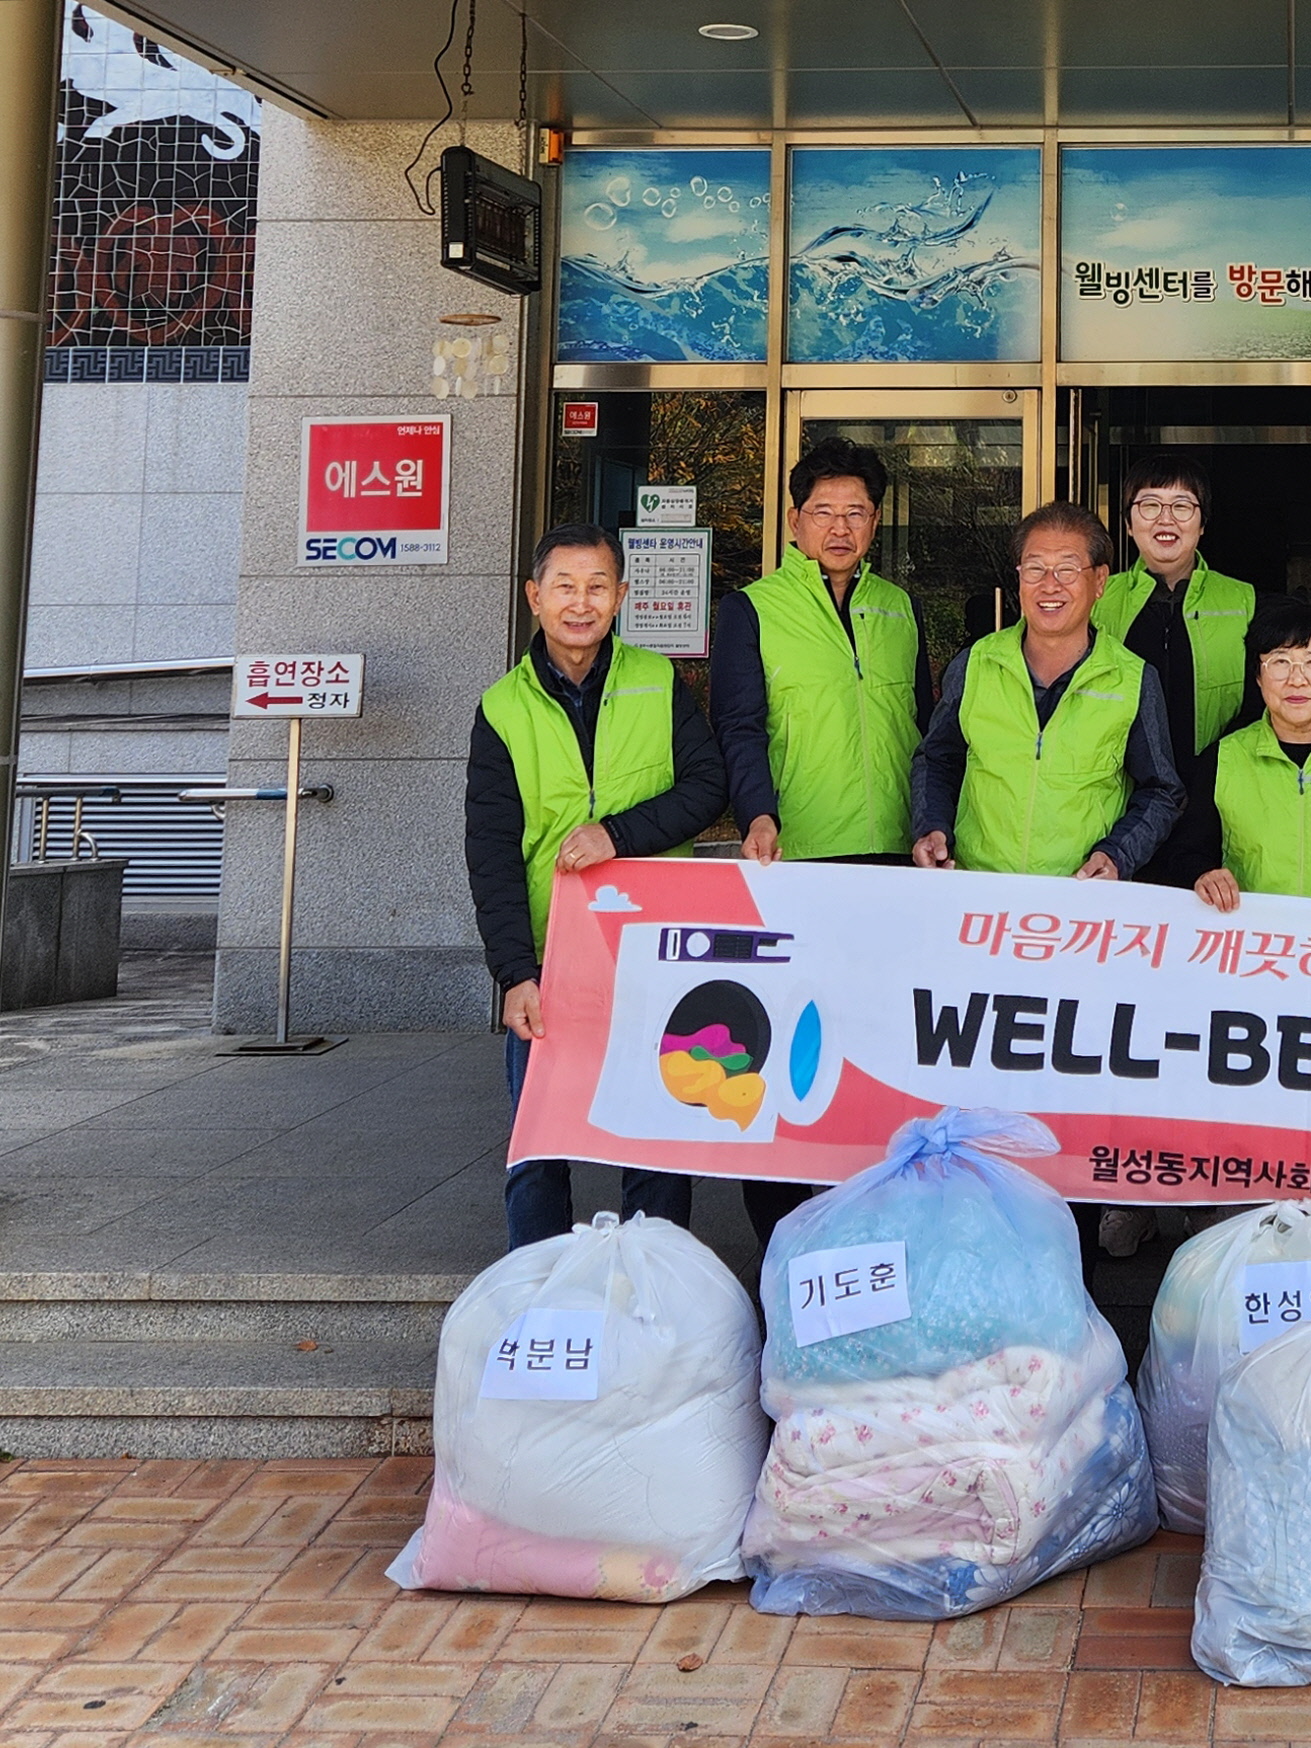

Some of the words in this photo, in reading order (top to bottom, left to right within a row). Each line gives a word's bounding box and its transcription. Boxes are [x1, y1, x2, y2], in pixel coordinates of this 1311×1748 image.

[1074, 261, 1215, 305] 웰빙센터를
[397, 425, 422, 436] 언제나
[423, 425, 441, 435] 안심
[325, 459, 424, 498] 에스원
[305, 536, 397, 561] SECOM
[400, 543, 441, 553] 1588-3112
[246, 660, 350, 688] 흡연장소
[307, 691, 350, 710] 정자
[958, 911, 1170, 969] 마음까지
[799, 1262, 897, 1310] 기도훈
[496, 1337, 594, 1371] 박분남
